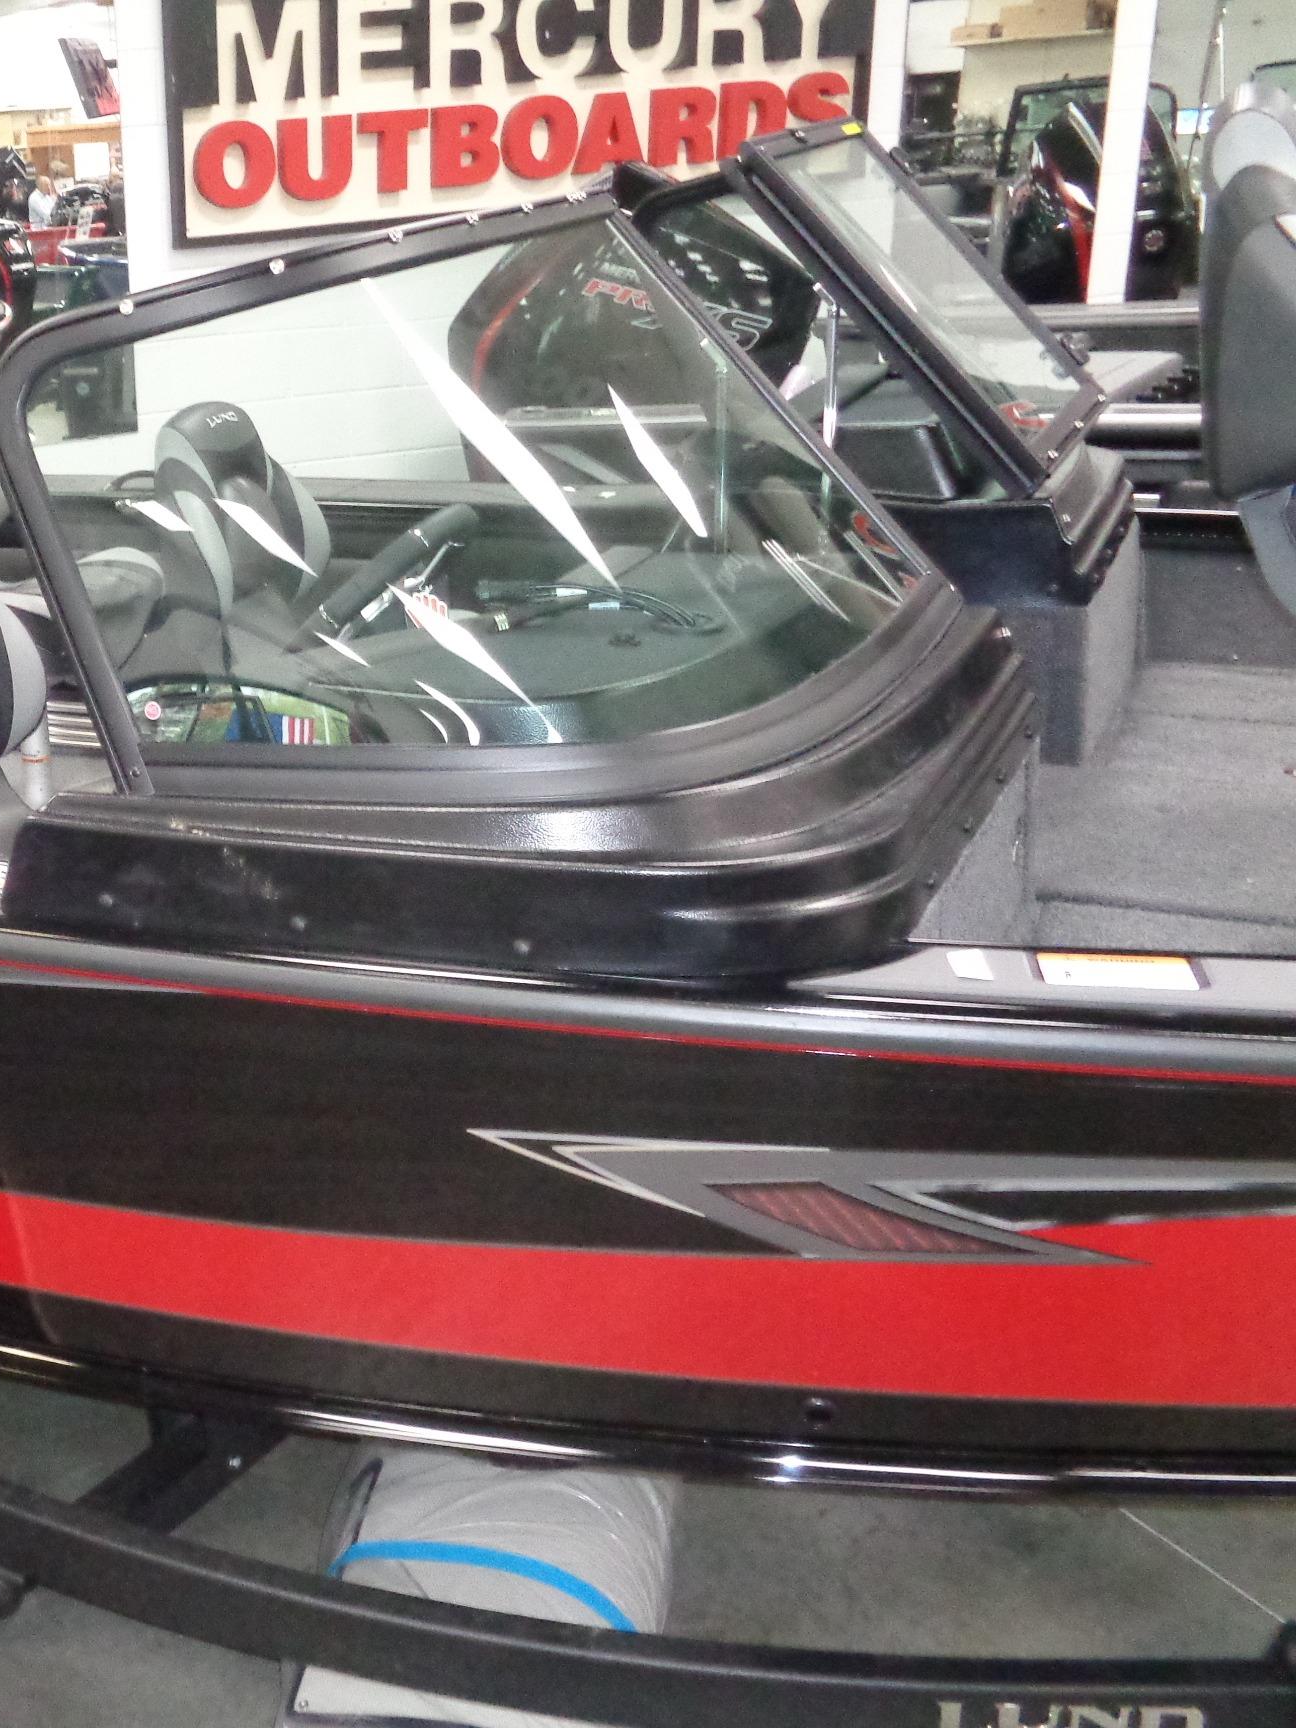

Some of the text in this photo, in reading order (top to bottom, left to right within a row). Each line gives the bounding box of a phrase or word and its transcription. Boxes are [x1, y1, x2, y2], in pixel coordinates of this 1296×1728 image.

[216, 0, 837, 104] MERCURY
[193, 71, 851, 208] OUTBOARDS
[206, 411, 239, 429] LUND
